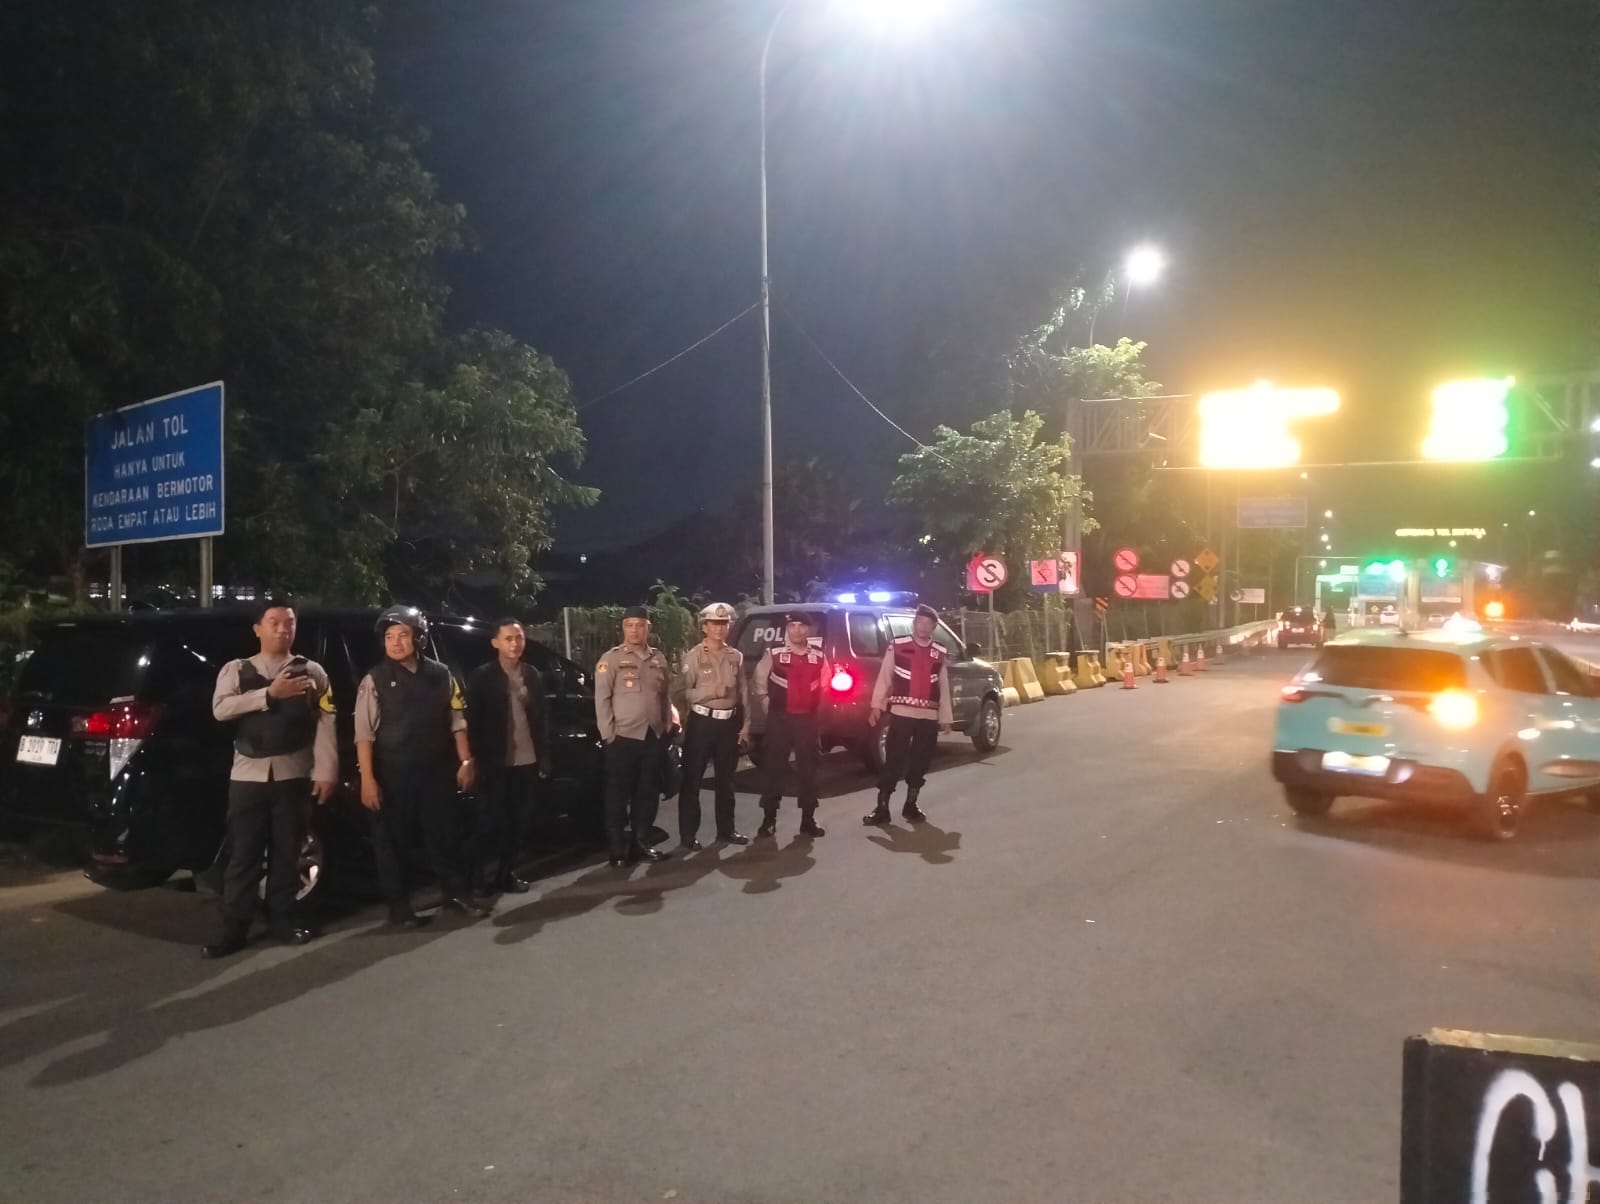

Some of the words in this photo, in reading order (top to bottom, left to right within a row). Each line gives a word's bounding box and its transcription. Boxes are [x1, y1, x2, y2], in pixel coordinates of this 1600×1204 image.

[111, 422, 154, 450] JALAN
[163, 414, 189, 439] TOL
[114, 459, 148, 479] HANYA
[152, 451, 185, 471] UNTUK
[92, 486, 149, 508] KENDARAAN
[157, 474, 213, 499] BERMOTOR
[118, 510, 148, 529] EMPAT
[153, 506, 179, 525] ATAU
[185, 501, 216, 521] LEBIH
